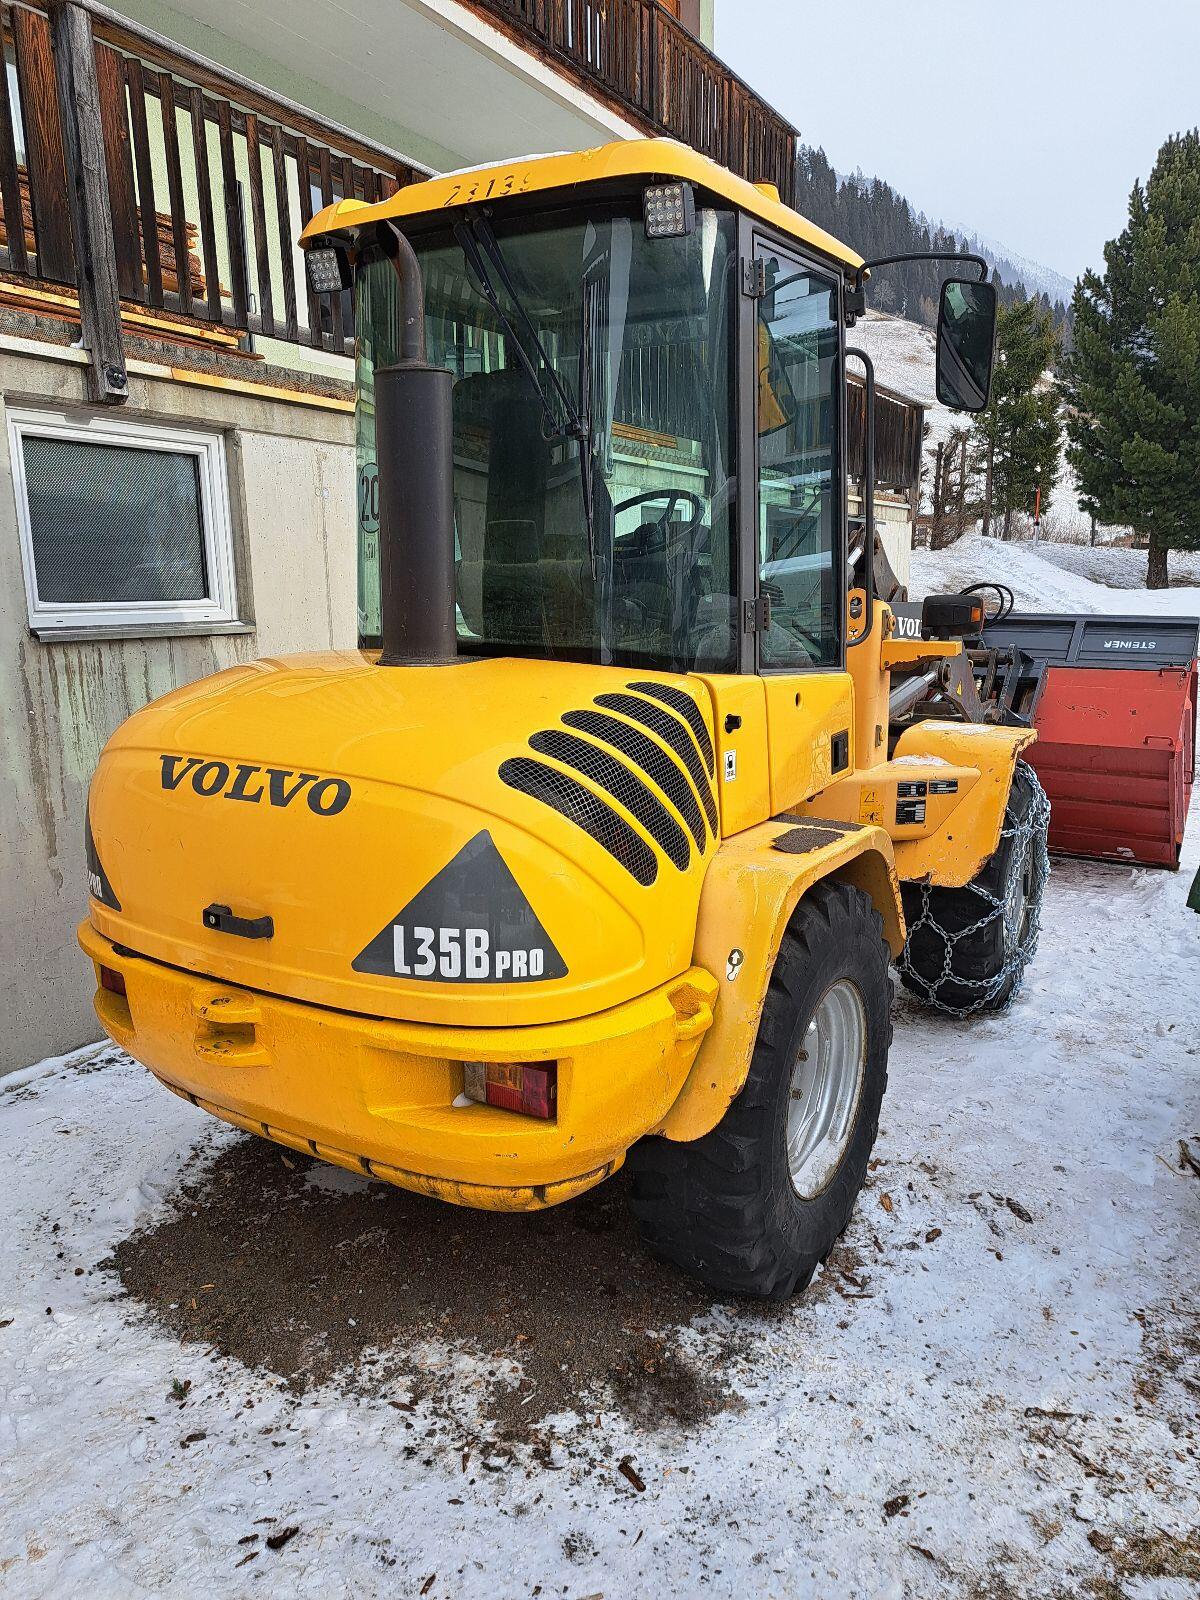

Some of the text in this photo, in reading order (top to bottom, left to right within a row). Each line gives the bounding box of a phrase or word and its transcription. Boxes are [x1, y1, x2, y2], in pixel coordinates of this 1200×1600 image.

[1104, 640, 1156, 649] STEINER
[160, 754, 351, 816] VOLVO
[393, 924, 544, 979] L35B PRO
